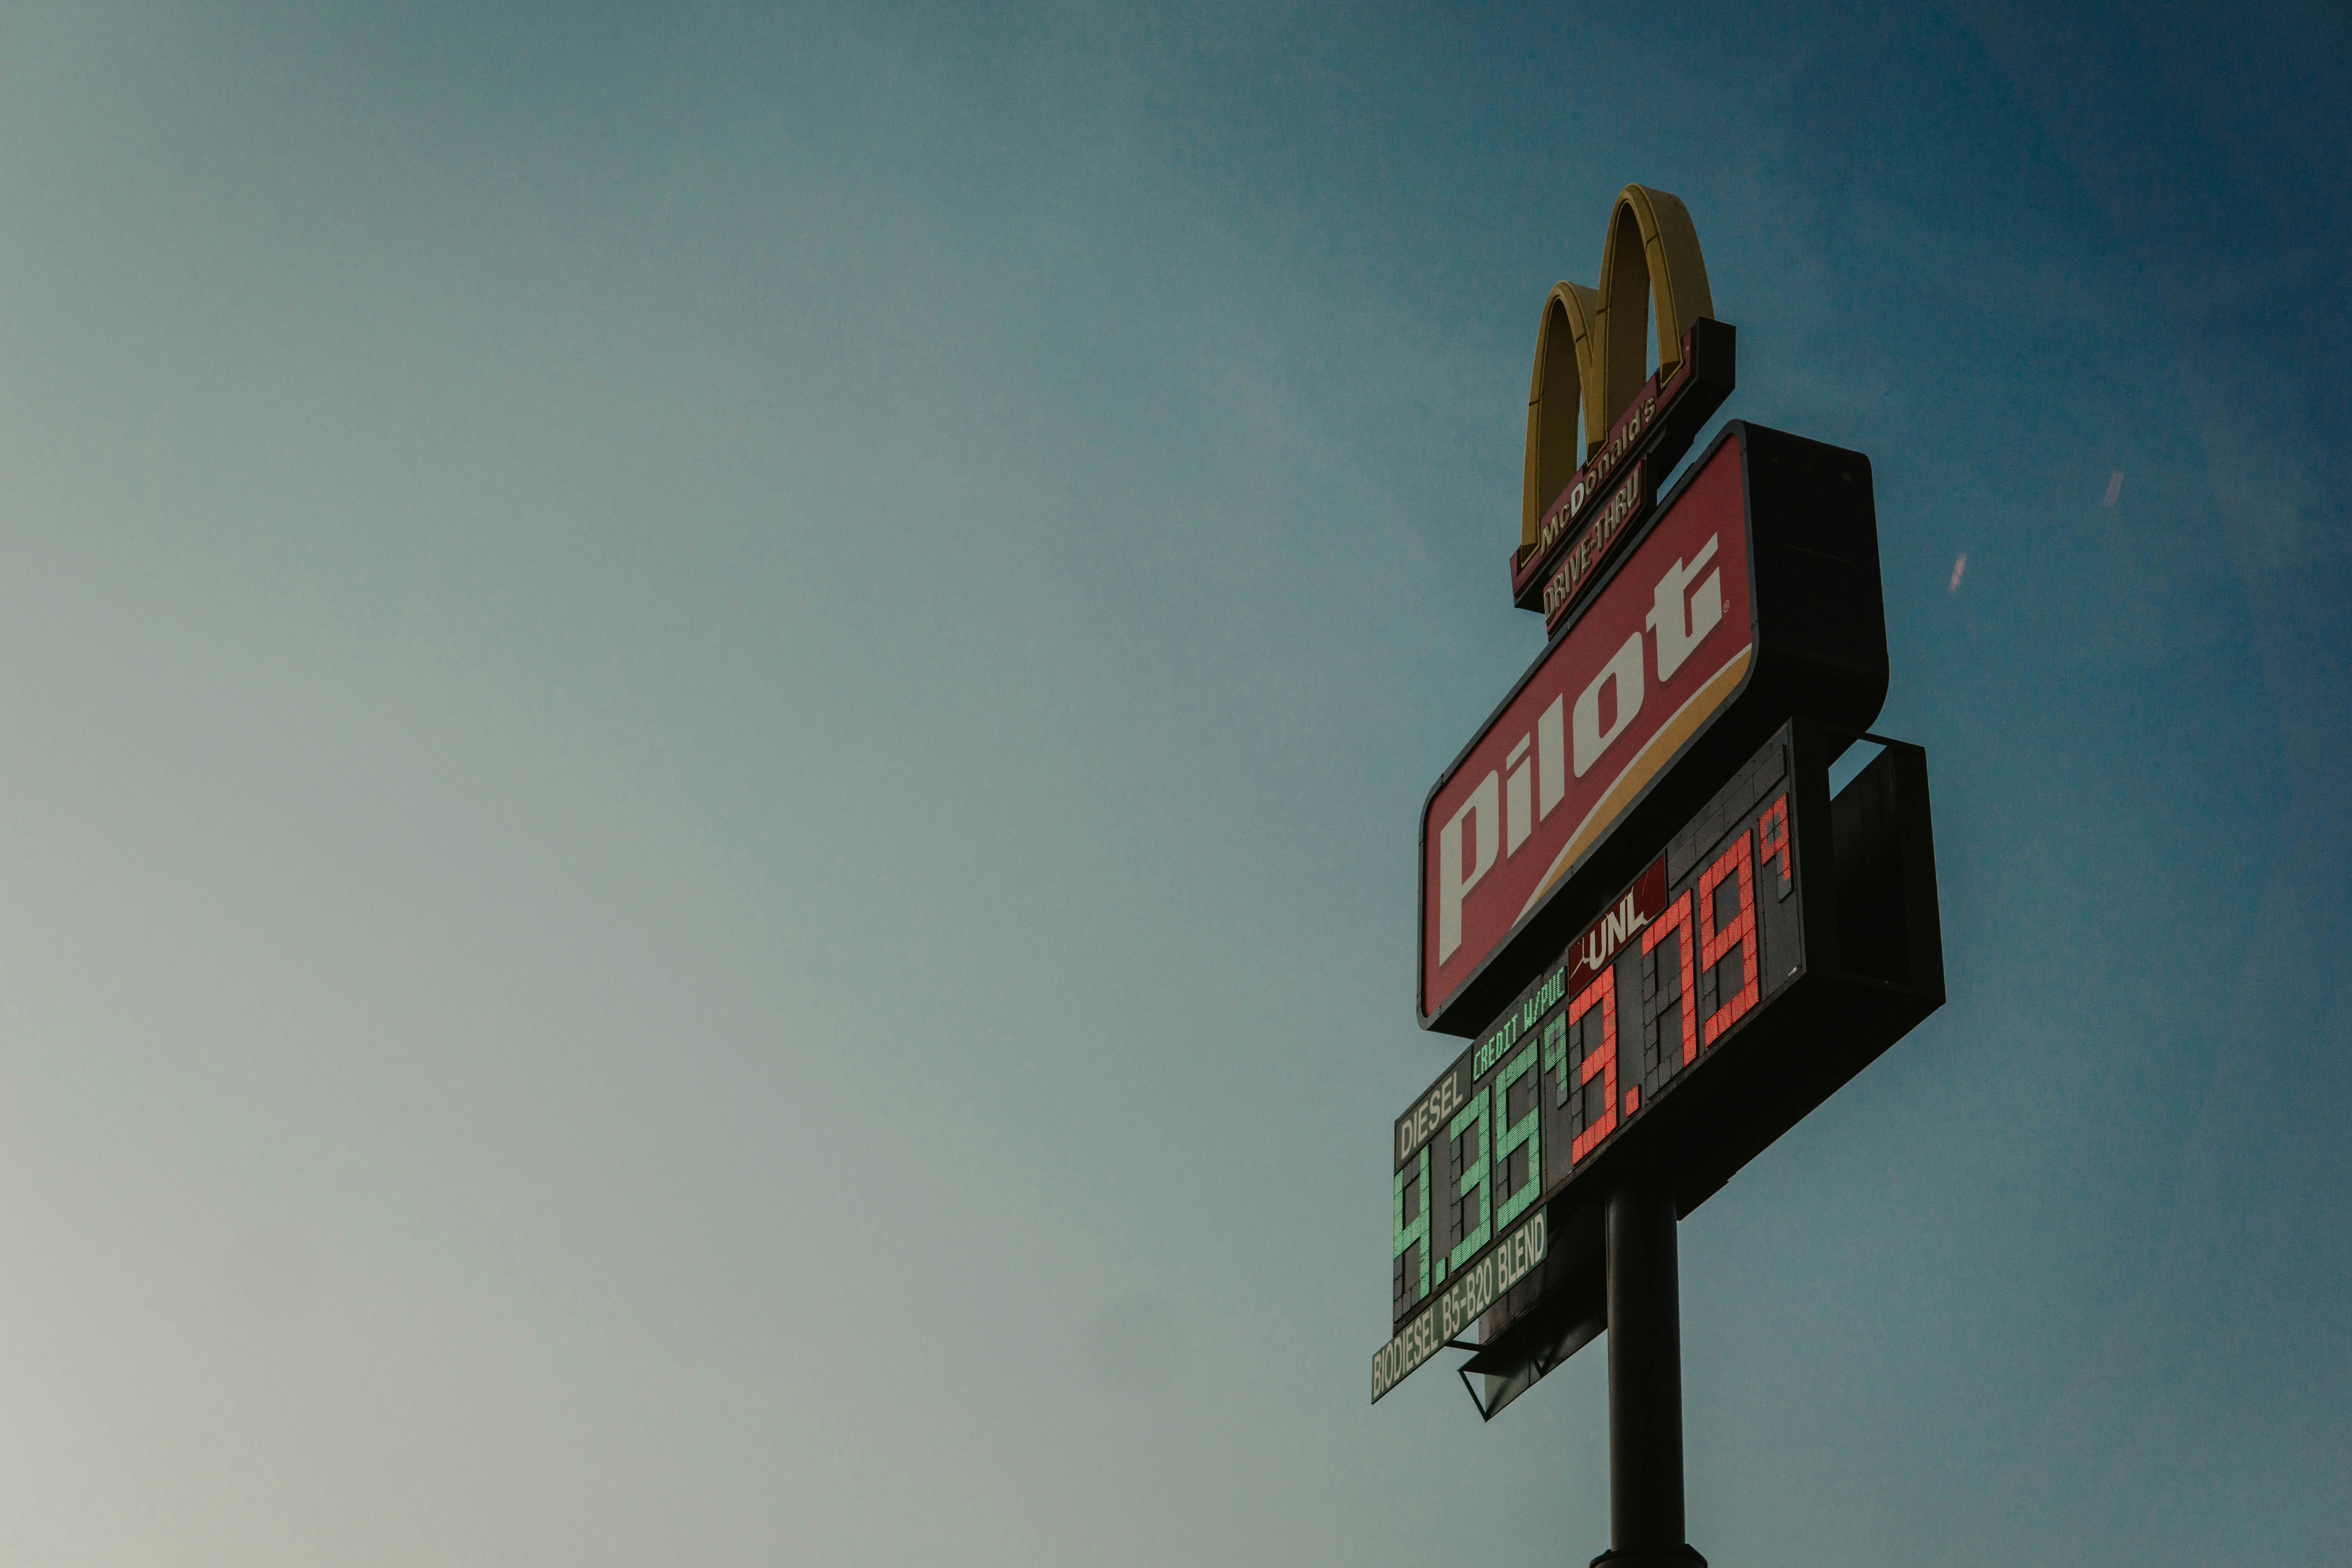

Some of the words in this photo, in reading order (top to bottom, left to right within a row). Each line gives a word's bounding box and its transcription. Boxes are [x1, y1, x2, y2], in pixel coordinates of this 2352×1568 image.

[1540, 396, 1657, 557] McDonald's
[1543, 467, 1641, 626] DRIVE-THRU
[1568, 828, 1760, 1166] 3.79
[1759, 793, 1791, 881] 9
[1589, 889, 1644, 971] UNL
[1400, 1071, 1463, 1160] DIESEL
[1474, 1013, 1518, 1081] CREDIT
[1393, 1038, 1540, 1300] 4.35
[1373, 1306, 1439, 1399] BIODIESEL
[1442, 1260, 1492, 1342] B5-B20
[1497, 1212, 1544, 1292] BLEND
